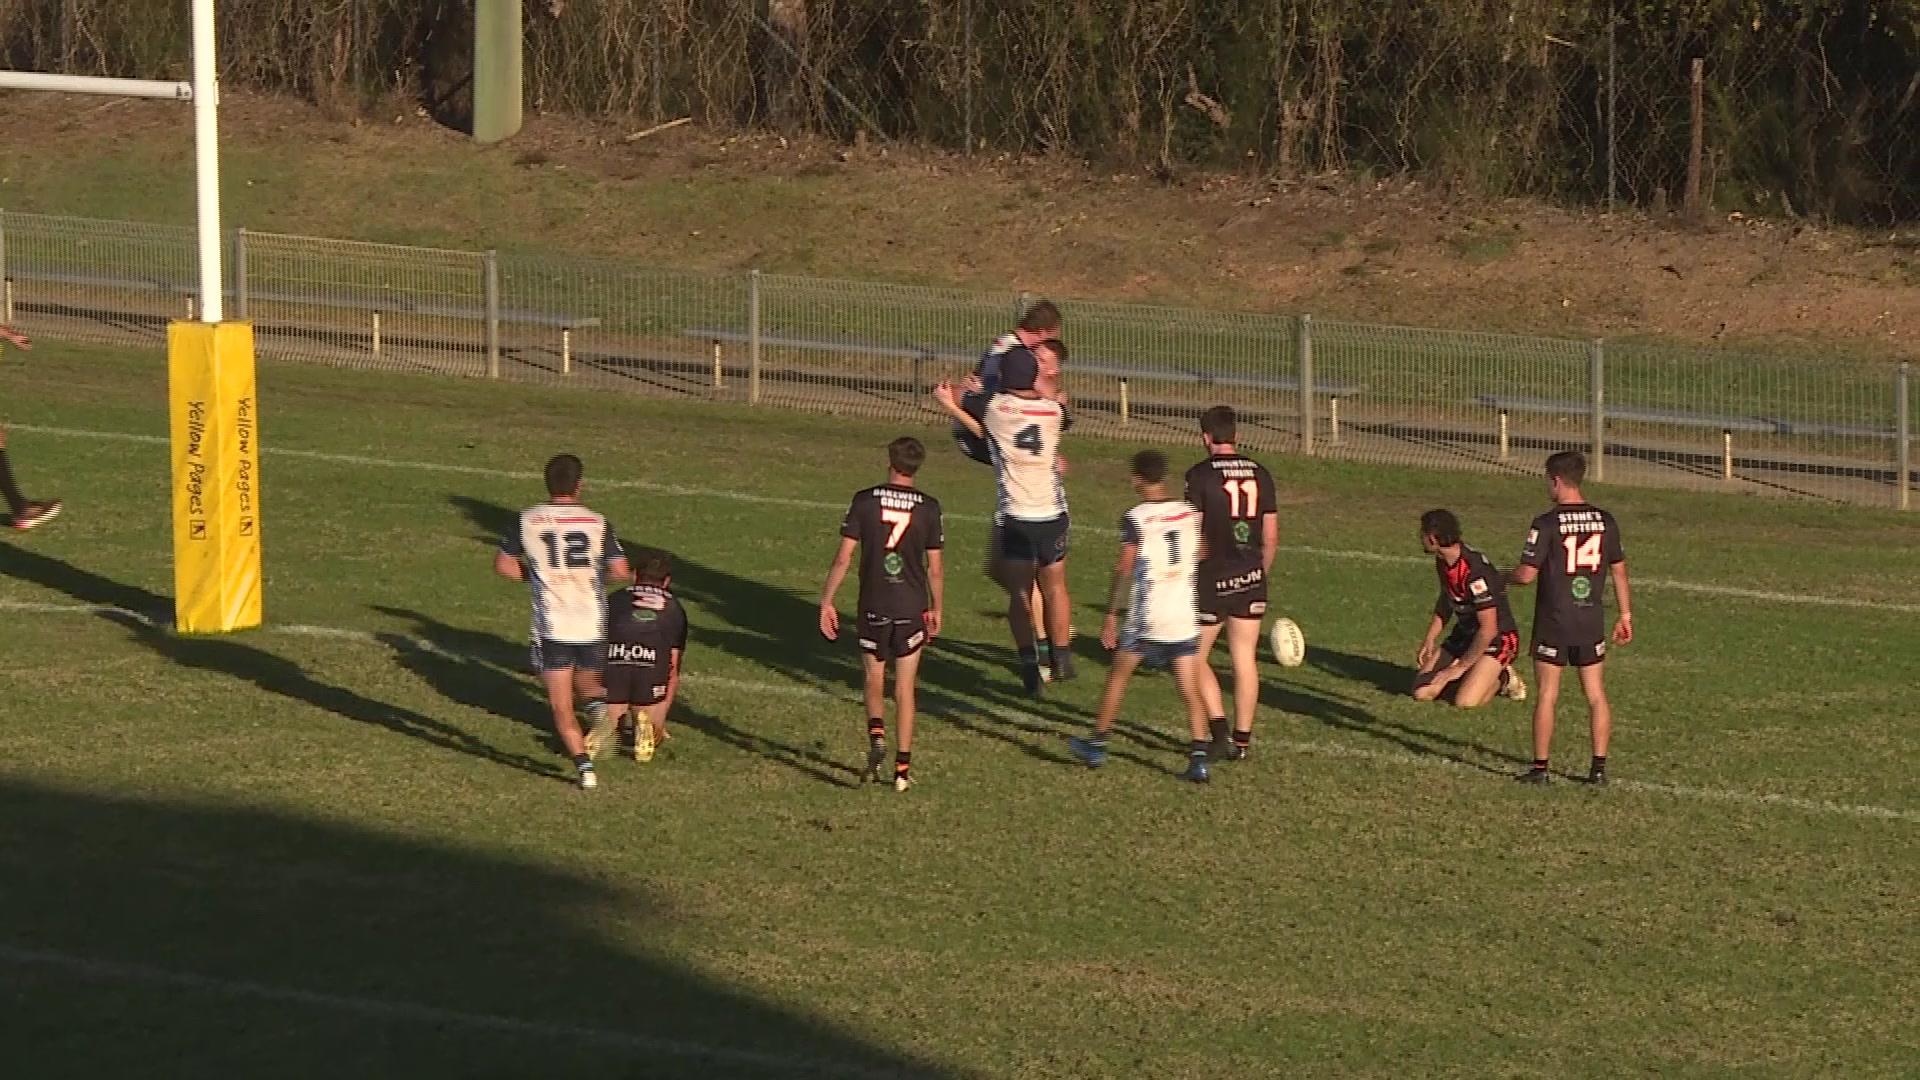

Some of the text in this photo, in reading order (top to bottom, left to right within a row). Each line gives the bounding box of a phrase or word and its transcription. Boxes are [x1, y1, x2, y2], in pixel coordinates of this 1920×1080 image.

[186, 401, 205, 514] Yellow Pages
[236, 398, 252, 512] Yellow Pages
[1013, 424, 1043, 456] 4
[880, 497, 915, 510] GROUP
[1223, 479, 1259, 519] 11
[881, 508, 913, 550] 7
[1163, 529, 1182, 565] 1
[537, 530, 592, 569] 12
[1562, 533, 1603, 575] 14
